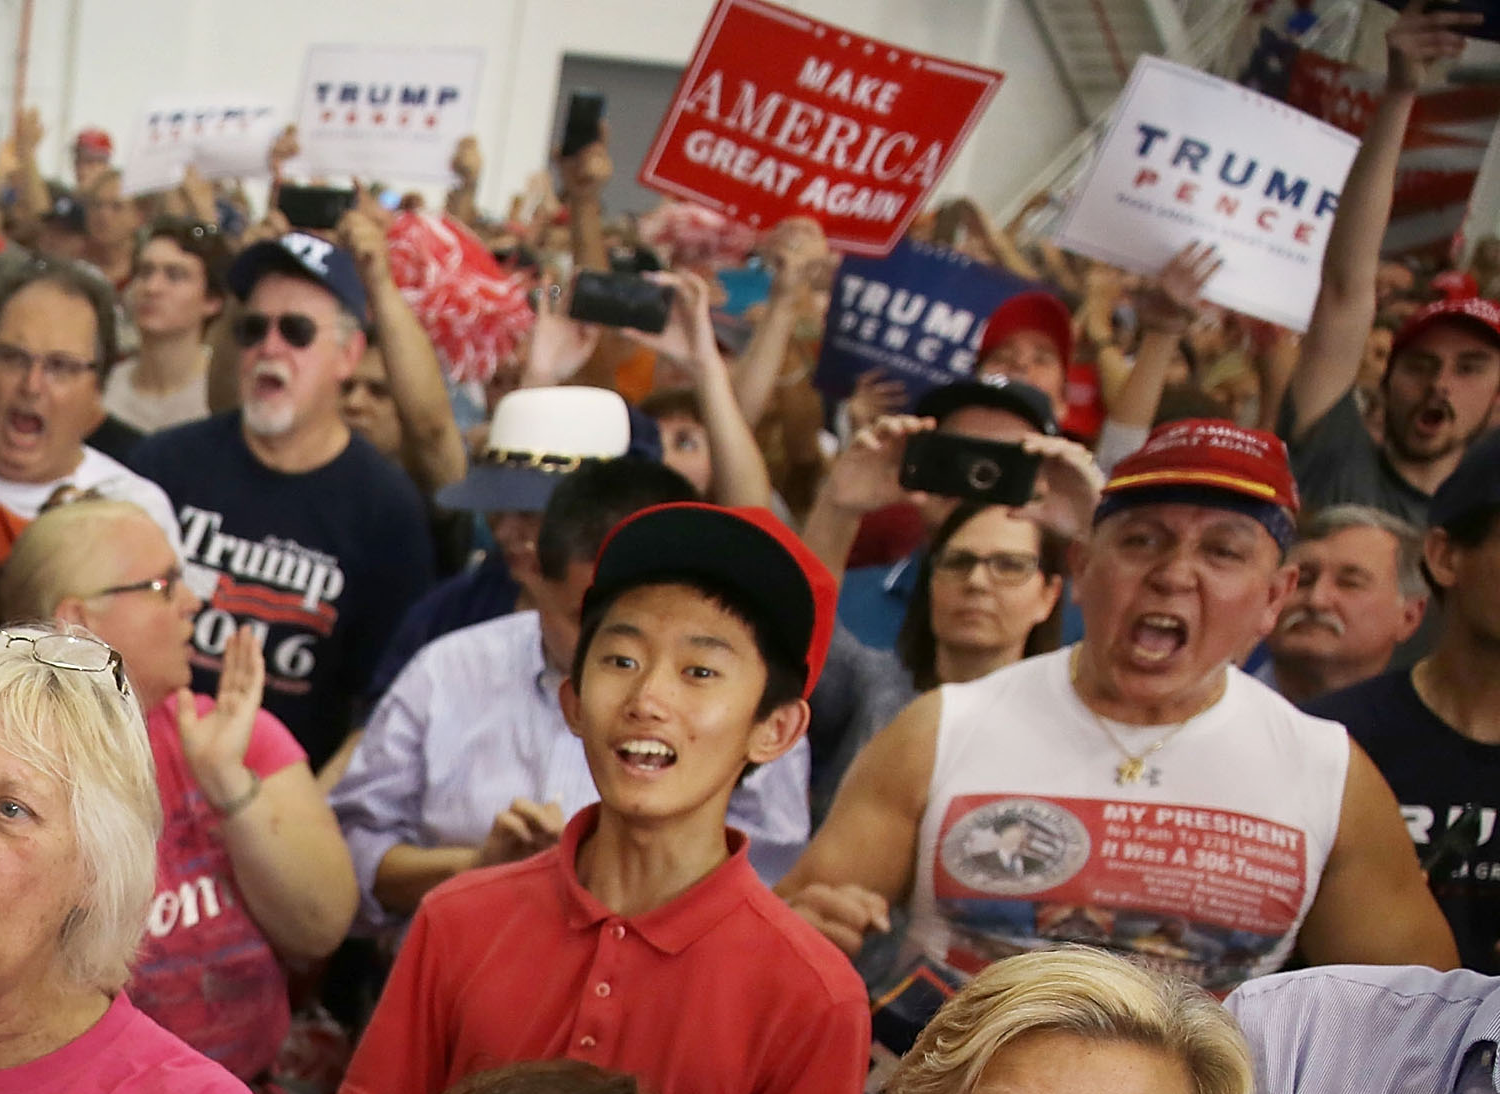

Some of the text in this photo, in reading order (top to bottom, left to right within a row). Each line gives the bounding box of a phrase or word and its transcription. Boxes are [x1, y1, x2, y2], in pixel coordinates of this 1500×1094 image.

[315, 81, 459, 106] TRUMP
[798, 56, 902, 115] MAKE
[683, 69, 944, 189] AMERICA
[684, 129, 908, 223] GREAT AGAIN
[1132, 167, 1316, 246] PENCE
[179, 504, 345, 613] Trump
[1103, 803, 1299, 851] MY PRESIDENT
[1171, 846, 1188, 866] A
